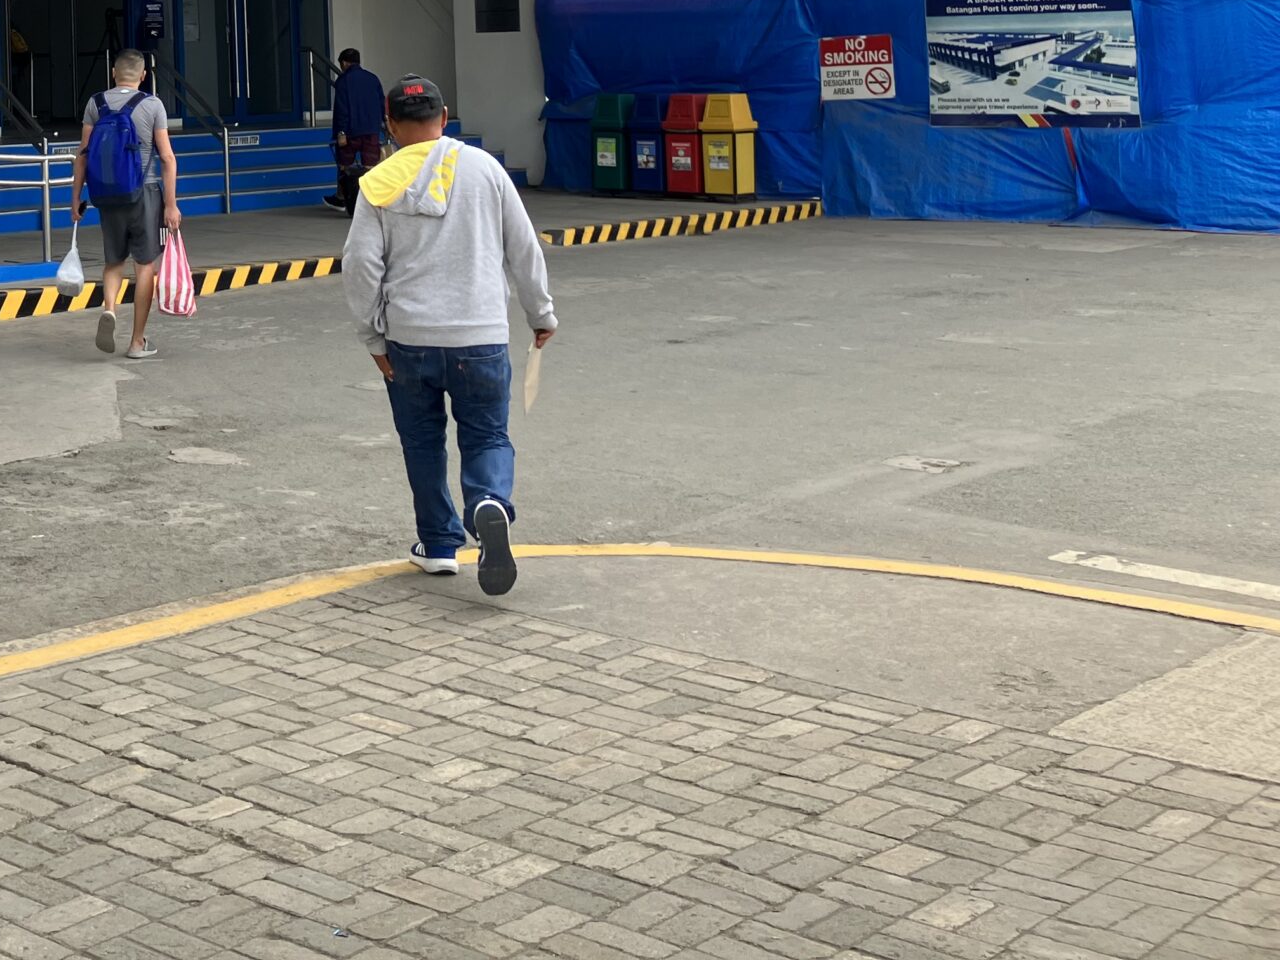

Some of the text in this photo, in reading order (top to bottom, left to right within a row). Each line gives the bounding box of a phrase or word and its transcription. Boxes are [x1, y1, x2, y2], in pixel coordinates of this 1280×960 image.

[945, 6, 981, 15] Batangas
[982, 5, 999, 13] Port
[1008, 3, 1038, 13] coming
[1039, 4, 1058, 12] your
[1059, 3, 1076, 11] way
[844, 38, 866, 51] NO
[824, 49, 889, 65] SMOKING
[826, 69, 860, 79] EXCEPT IN
[823, 78, 864, 87] DESIGNATED
[832, 87, 855, 95] AREAS
